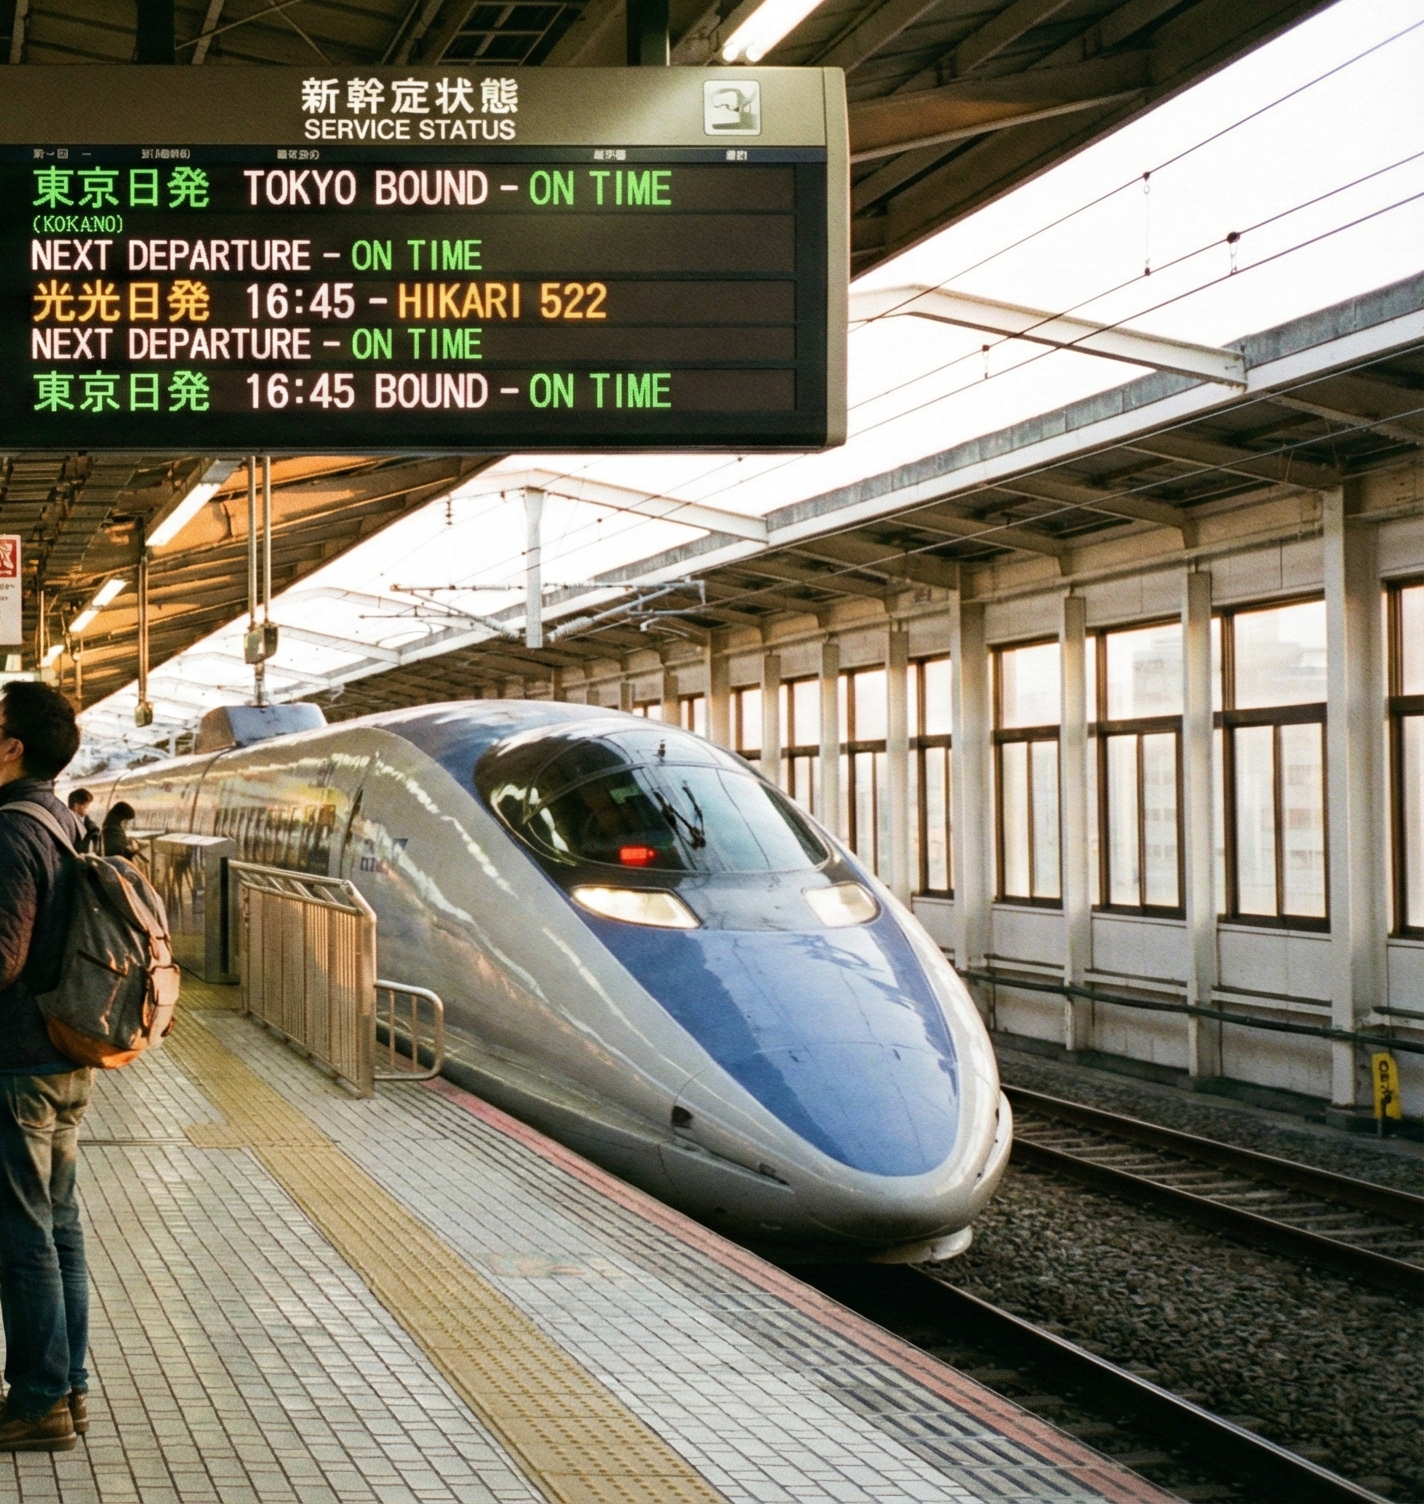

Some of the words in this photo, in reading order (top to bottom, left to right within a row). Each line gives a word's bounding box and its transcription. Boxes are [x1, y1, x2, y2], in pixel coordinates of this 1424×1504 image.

[305, 118, 411, 140] SERVICE
[419, 119, 516, 140] STATUS
[32, 165, 211, 209] 東京日発
[243, 169, 357, 206] TOKYO
[375, 169, 489, 206] BOUND
[529, 170, 575, 206] ON
[588, 170, 672, 206] TIME
[32, 214, 123, 234] (KOKANO)
[31, 238, 114, 271] NEXT
[128, 239, 311, 271] DEPARTURE
[351, 239, 392, 271] ON
[407, 239, 483, 271] TIME
[33, 278, 211, 323] 光光日発
[246, 282, 356, 320] 16:45
[398, 281, 521, 320] HIKARI
[540, 281, 608, 320] 522
[31, 327, 114, 360] NEXT
[128, 327, 312, 360] DEPARTURE
[351, 327, 393, 360] ON
[407, 327, 483, 360] TIME
[33, 369, 211, 413] 東京日発
[246, 372, 356, 409] 16:45
[374, 372, 489, 409] BOUND
[529, 372, 574, 409] ON
[589, 372, 672, 409] TIME
